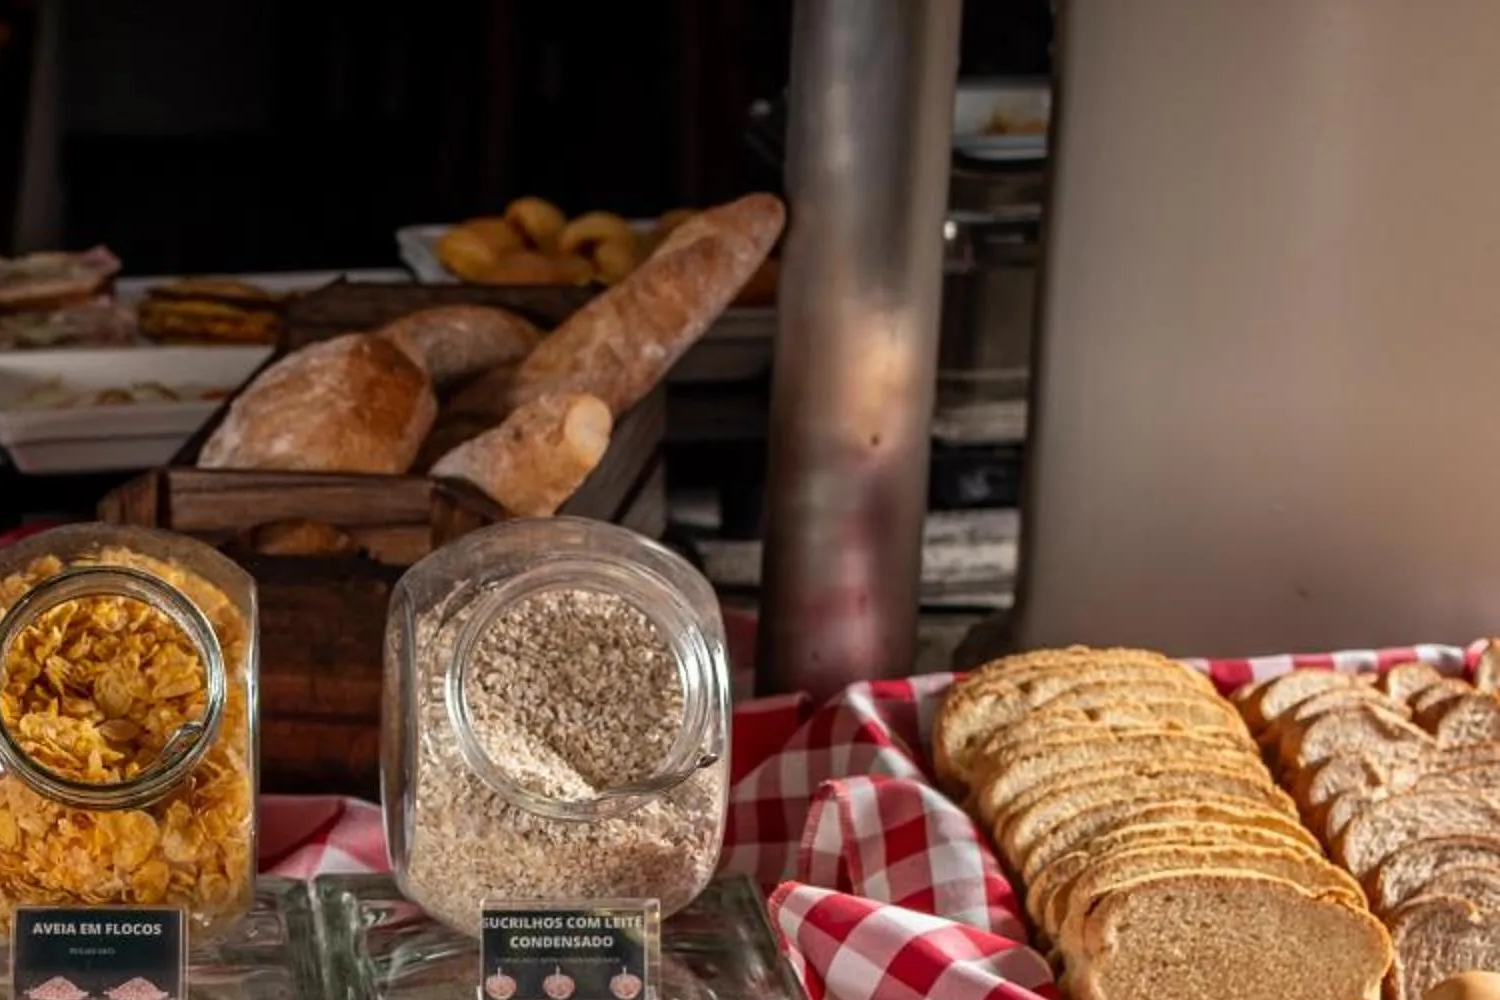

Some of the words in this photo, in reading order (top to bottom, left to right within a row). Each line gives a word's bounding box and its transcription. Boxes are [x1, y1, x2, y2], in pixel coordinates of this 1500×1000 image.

[32, 922, 77, 935] AVEIA
[80, 923, 101, 935] EM
[105, 923, 162, 936] FLOCOS
[566, 917, 600, 929] COM
[509, 935, 614, 949] CONDENSADO
